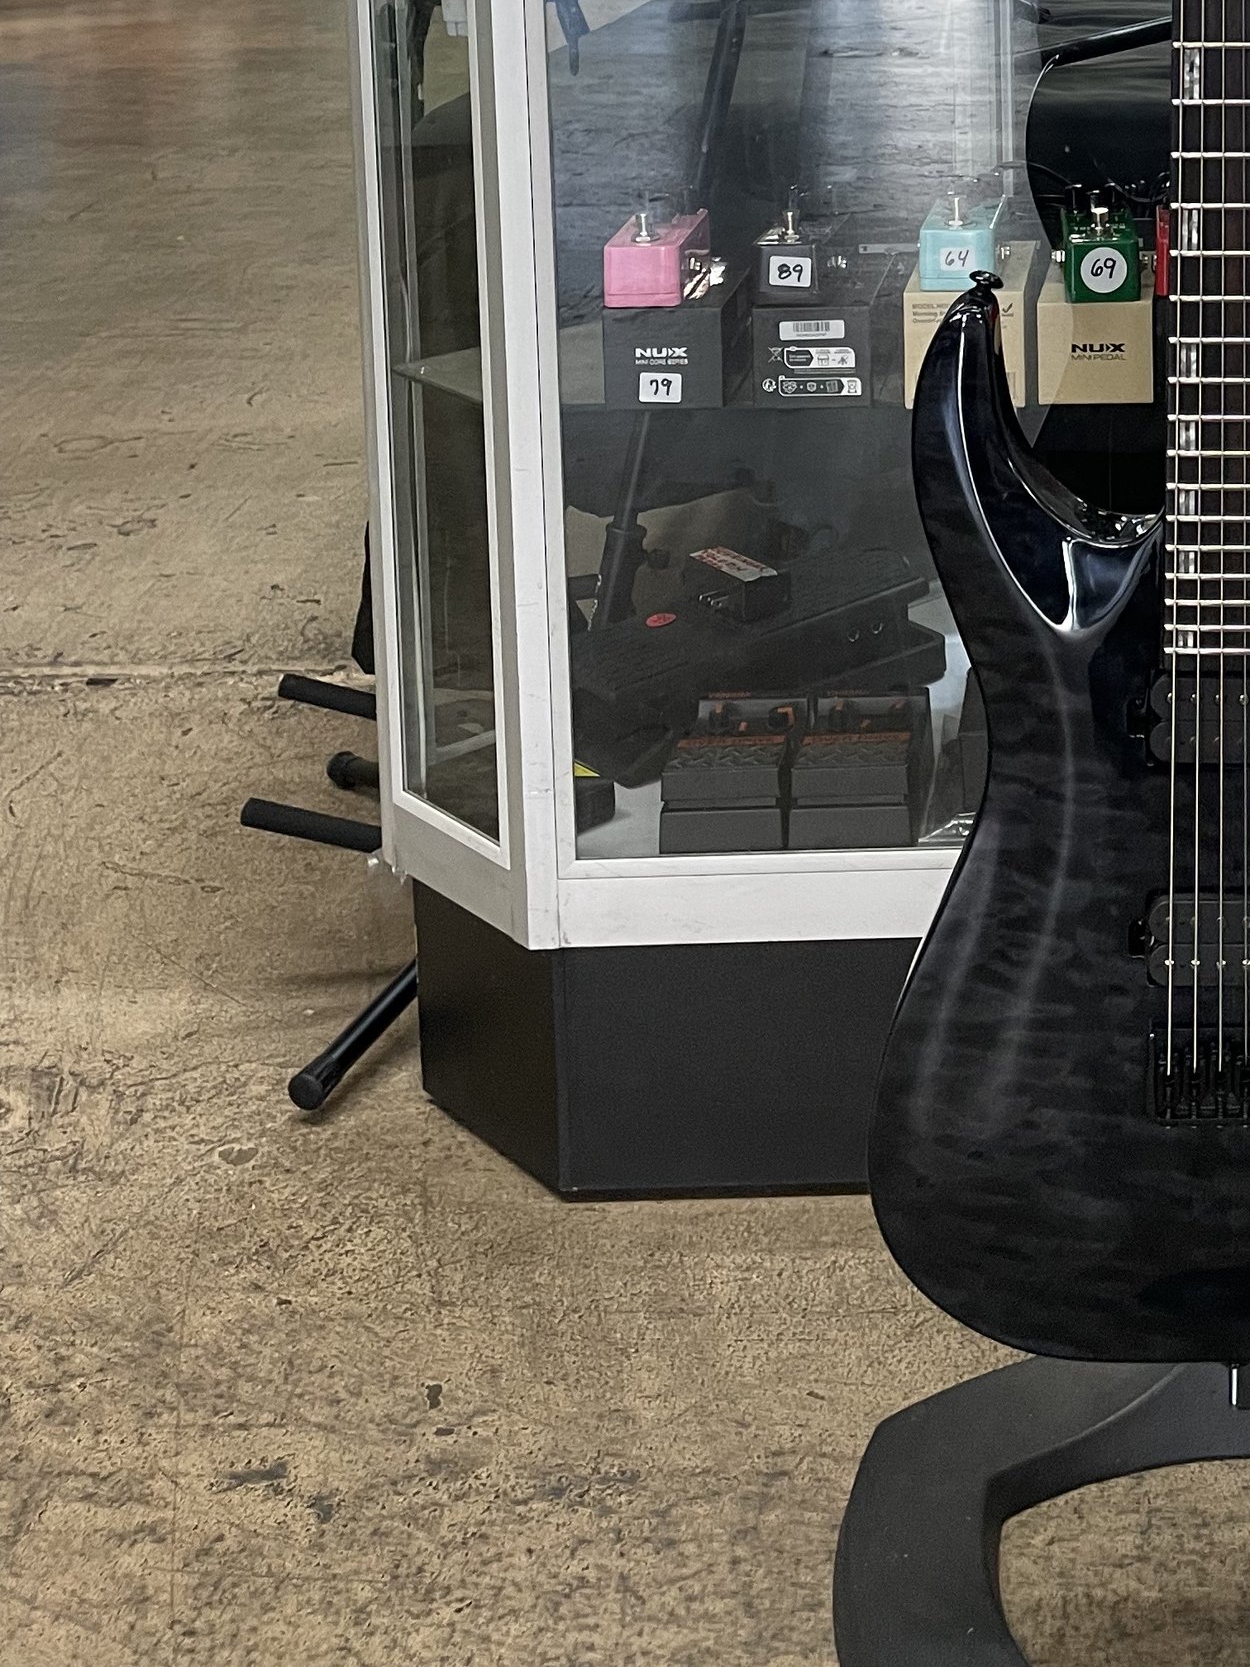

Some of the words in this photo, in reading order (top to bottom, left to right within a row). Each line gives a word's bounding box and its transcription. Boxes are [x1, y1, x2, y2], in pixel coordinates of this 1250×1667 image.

[944, 249, 970, 268] 64
[777, 262, 804, 283] 89
[1090, 257, 1117, 280] 69
[635, 347, 688, 358] NUX
[1071, 343, 1126, 353] NUX
[1071, 353, 1093, 361] MINI
[1093, 353, 1126, 361] PEDAL
[649, 377, 673, 397] 79
